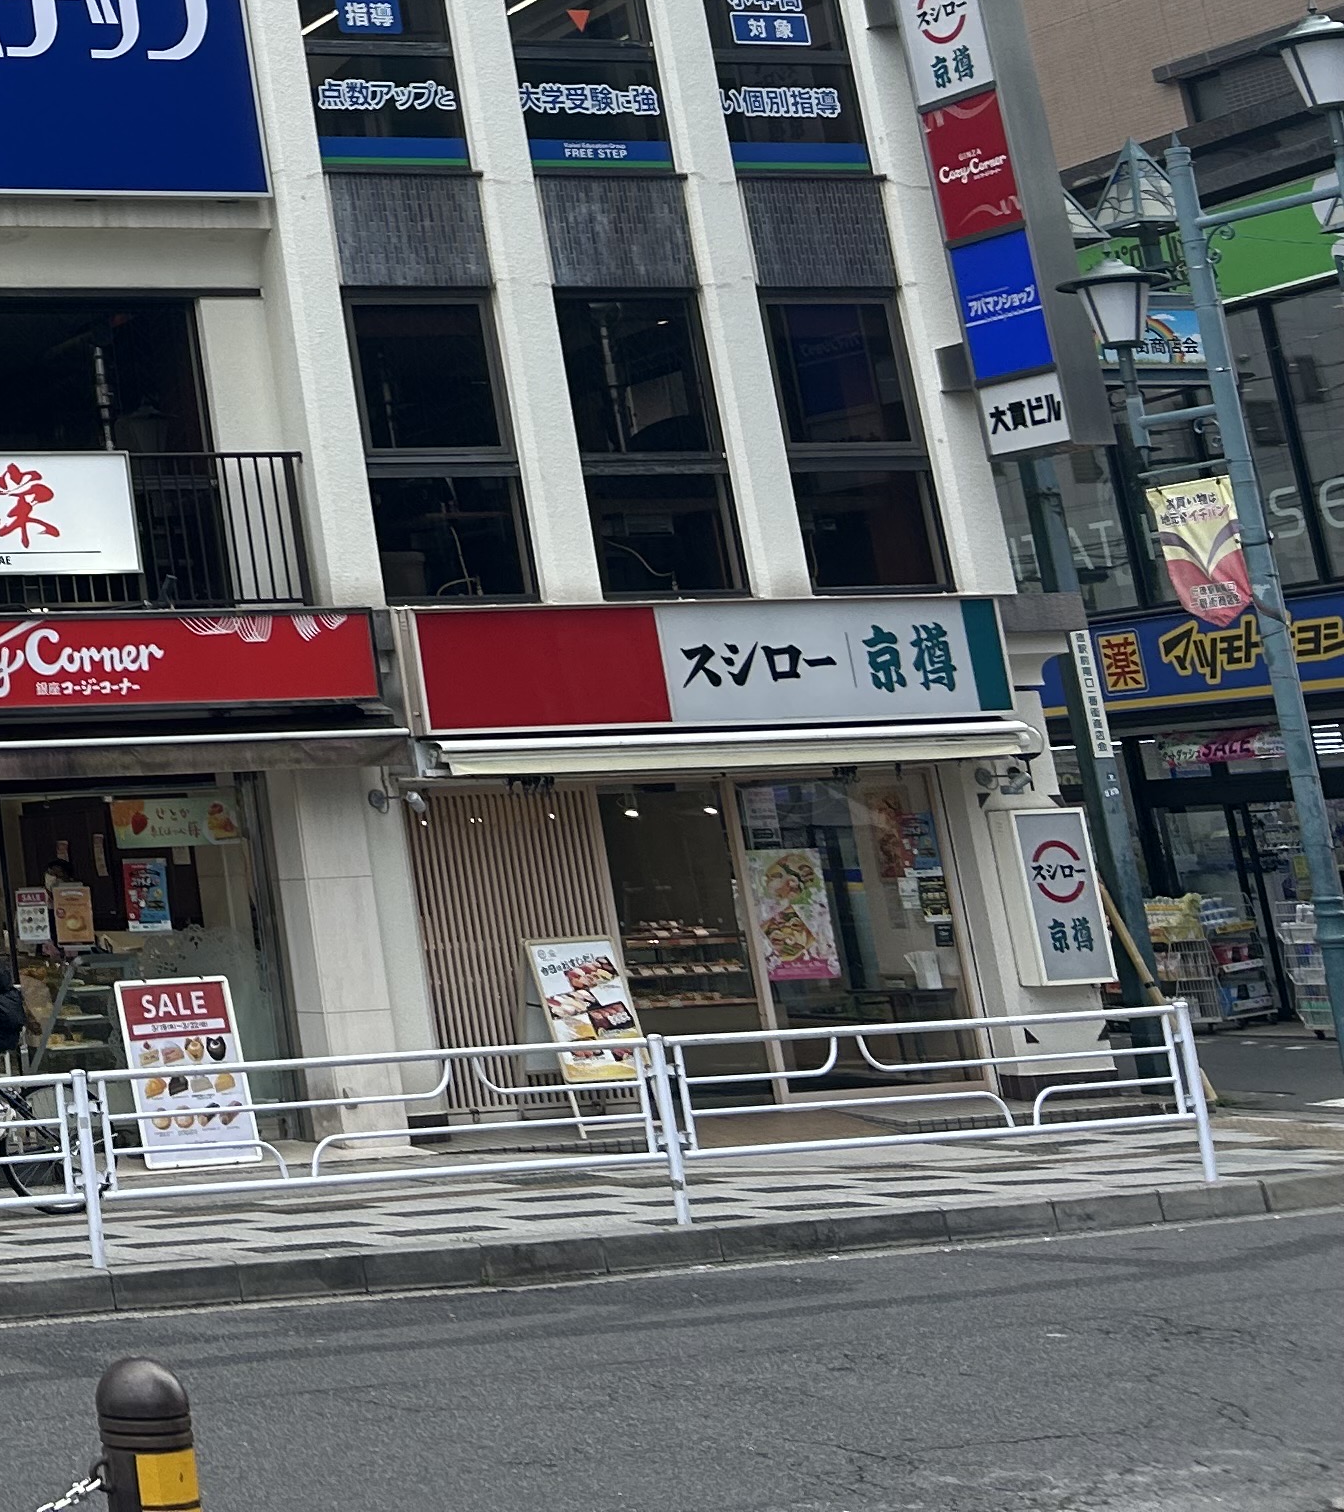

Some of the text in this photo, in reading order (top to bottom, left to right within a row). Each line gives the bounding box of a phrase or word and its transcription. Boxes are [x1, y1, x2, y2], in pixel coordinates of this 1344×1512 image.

[345, 2, 396, 28] 指導
[749, 18, 794, 39] 対象
[916, 0, 968, 31] スシロー
[930, 45, 976, 90] 京樽
[318, 78, 841, 118] 点数アップと 大学受験に強 い個別指導
[564, 148, 628, 159] FREE STEP
[939, 166, 970, 184] Cozy
[969, 155, 1007, 174] Corner
[968, 284, 1035, 317] アパマンショップ
[989, 393, 1062, 436] 大貫ビル
[1160, 503, 1230, 526] 地元がイチバン
[1166, 492, 1217, 509] お買い物は
[24, 627, 165, 676] Corner
[680, 621, 958, 693] スシロー 京樽
[1101, 635, 1143, 688] 薬
[36, 678, 141, 696] 銀座コージーコーナー
[1031, 863, 1087, 882] スシロー
[21, 893, 42, 902] SALE
[1048, 916, 1094, 953] 京樽
[141, 991, 208, 1019] SALE
